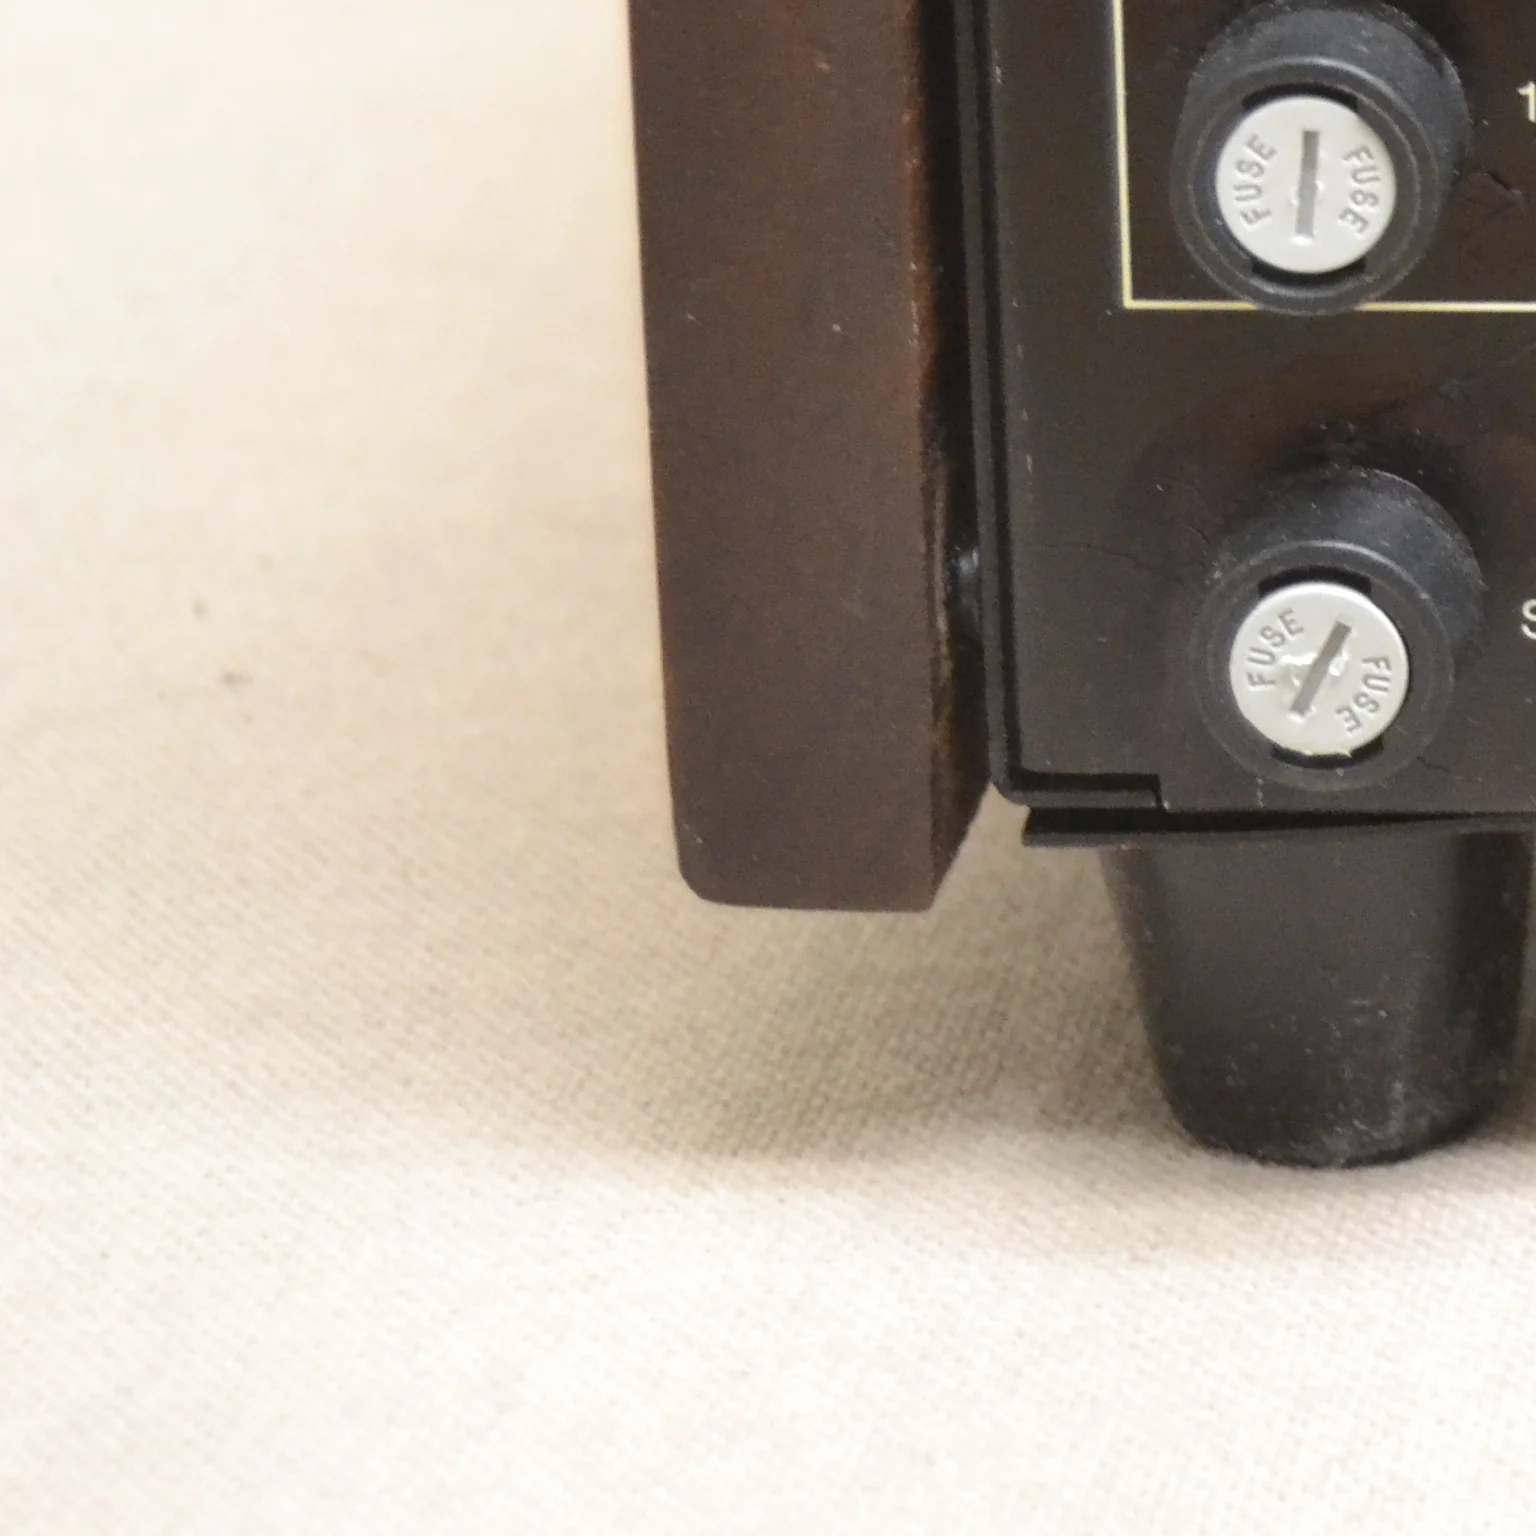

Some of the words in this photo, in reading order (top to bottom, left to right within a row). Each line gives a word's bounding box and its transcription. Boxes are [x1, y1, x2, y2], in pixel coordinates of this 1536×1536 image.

[1518, 82, 1536, 122] 1
[1233, 133, 1278, 227] FUSE
[1341, 144, 1382, 234] FUSE
[1246, 608, 1305, 688] FUSE
[1335, 656, 1393, 734] FUSE
